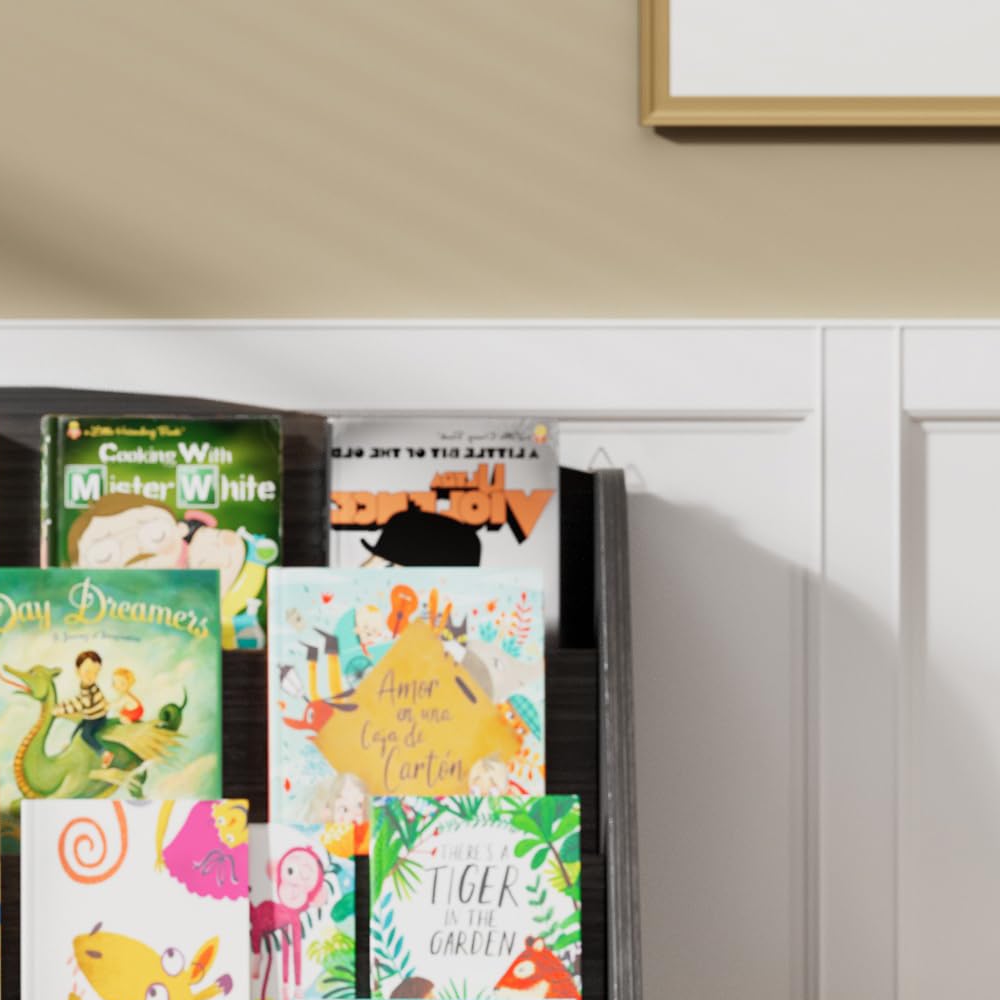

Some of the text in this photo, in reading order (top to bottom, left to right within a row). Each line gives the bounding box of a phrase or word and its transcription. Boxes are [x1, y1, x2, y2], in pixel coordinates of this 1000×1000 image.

[98, 441, 233, 468] Cooking With
[70, 472, 277, 502] Mister White
[64, 576, 209, 638] Dreamers
[378, 668, 440, 704] Amor
[420, 710, 453, 722] una
[384, 748, 465, 794] Cartón
[424, 862, 520, 908] TIGER
[444, 908, 496, 928] IN THE
[429, 930, 517, 957] GARDEN
